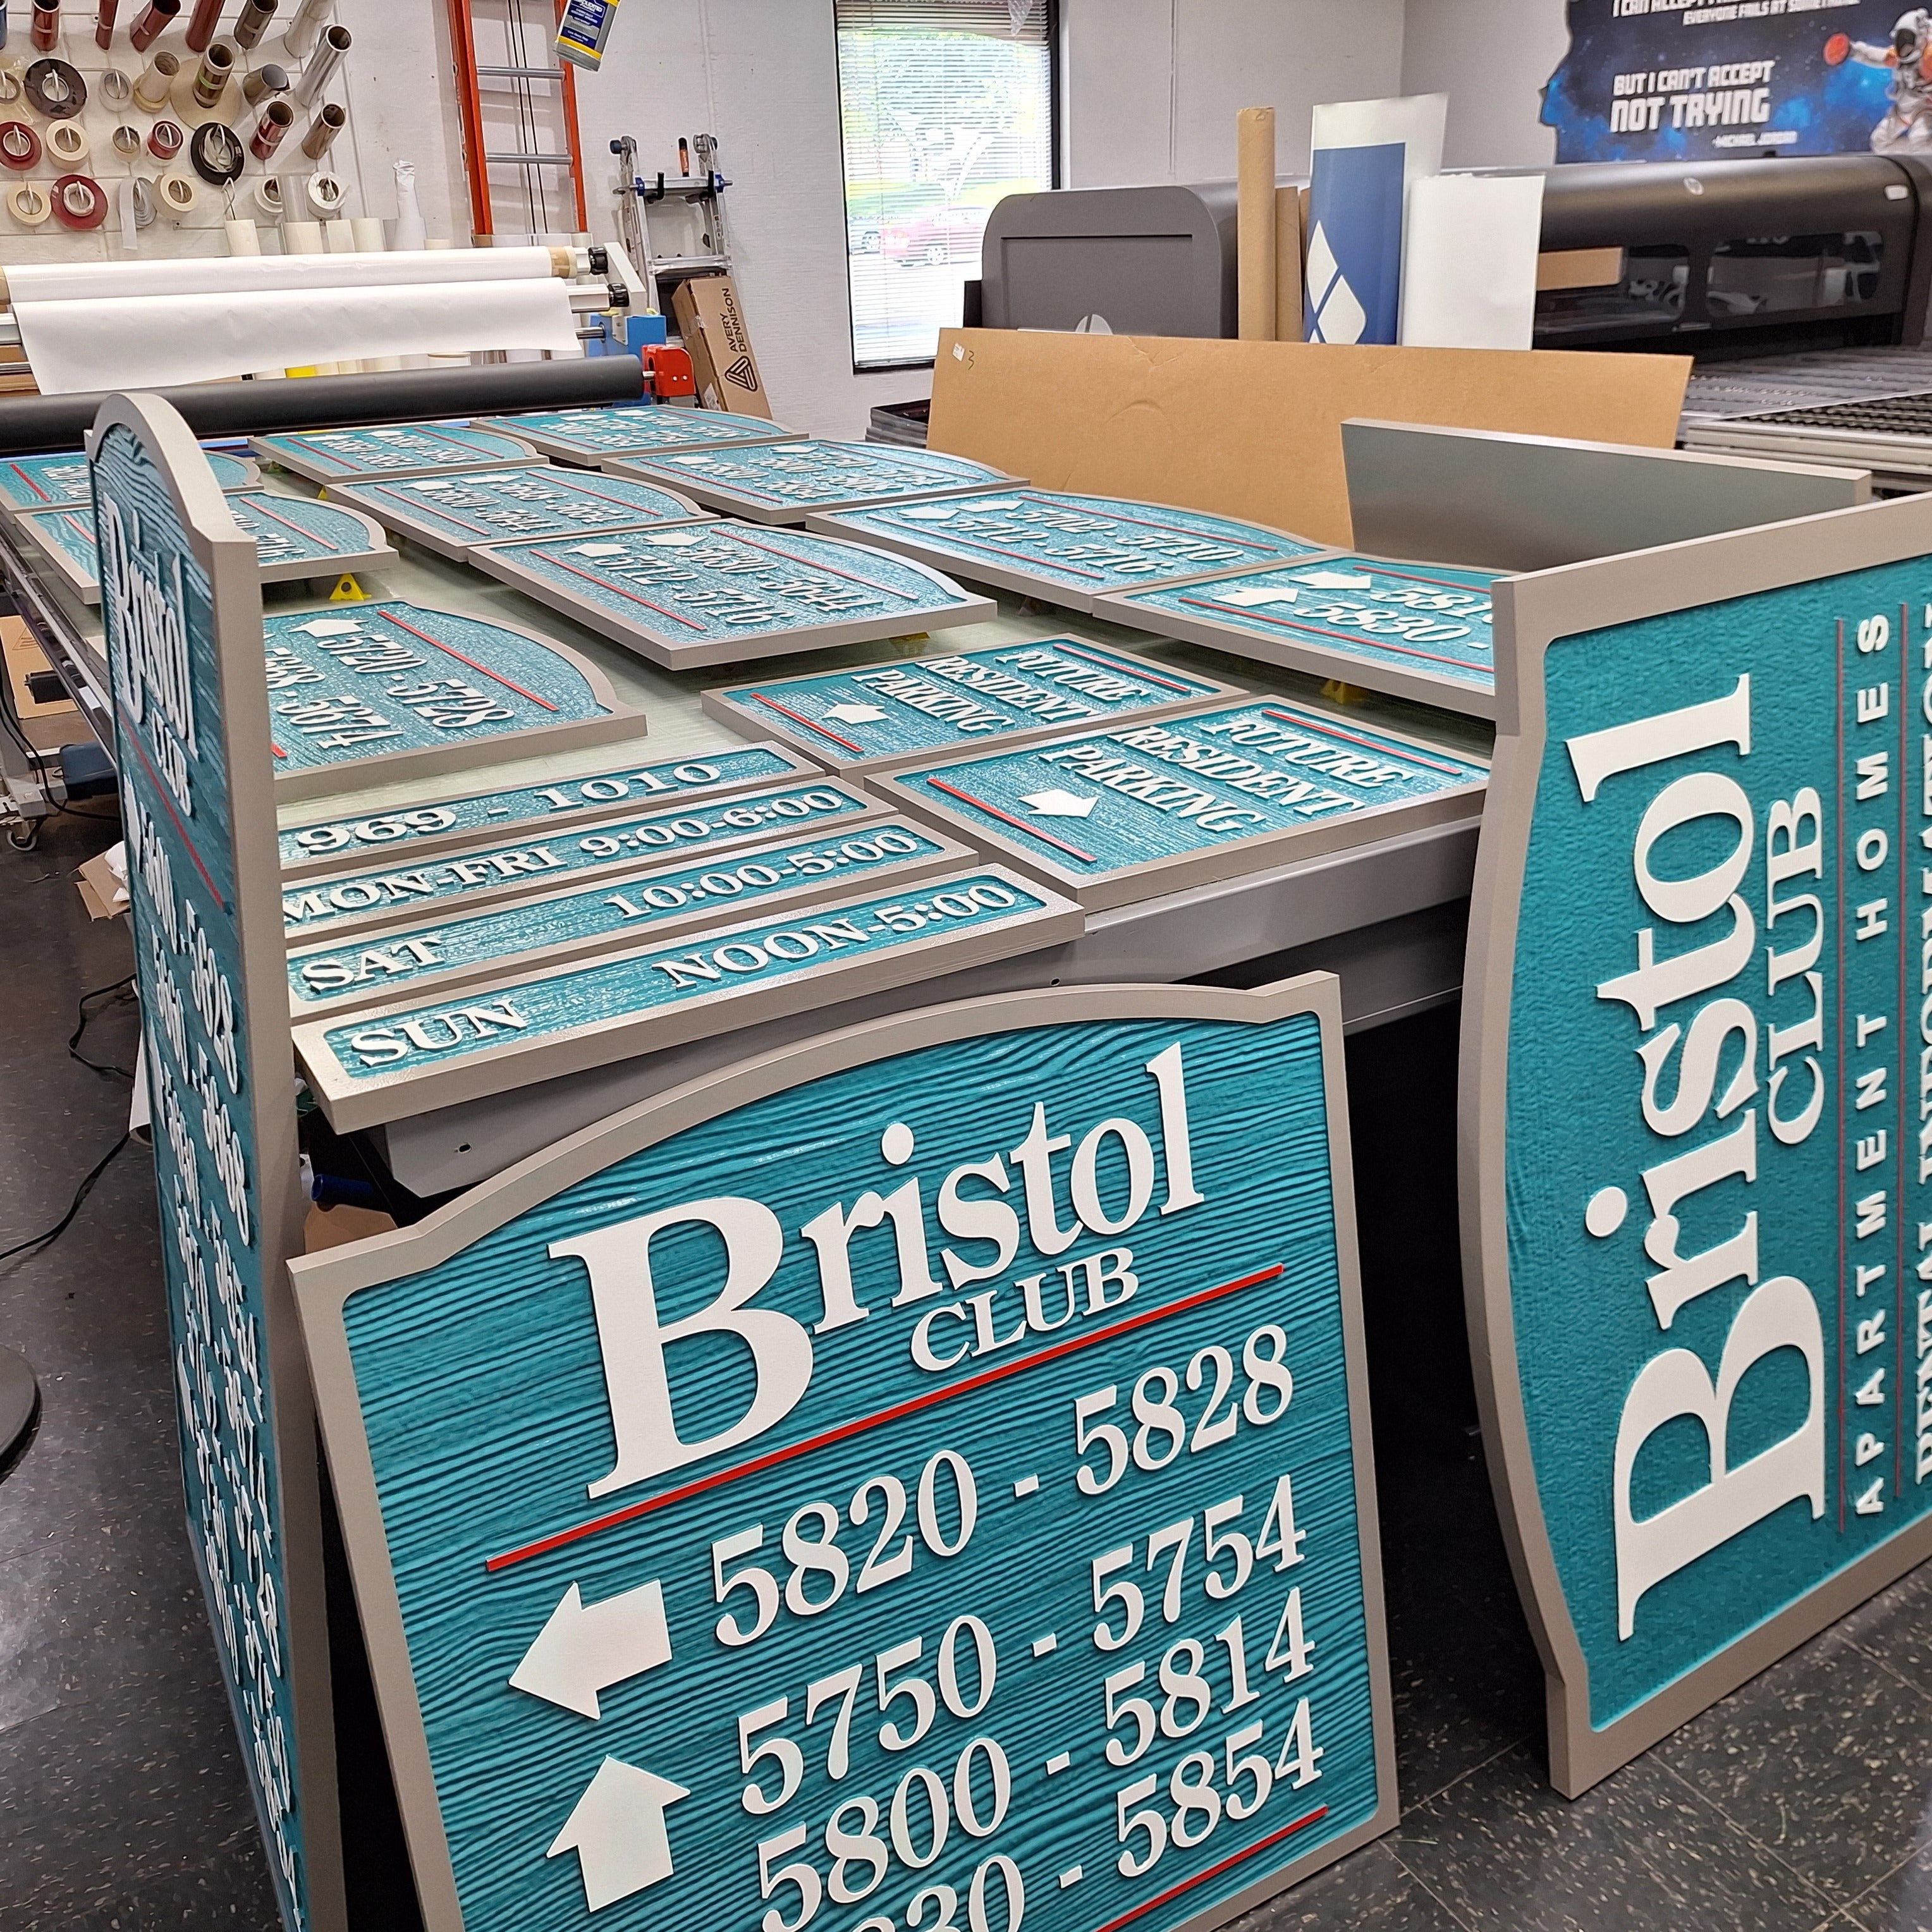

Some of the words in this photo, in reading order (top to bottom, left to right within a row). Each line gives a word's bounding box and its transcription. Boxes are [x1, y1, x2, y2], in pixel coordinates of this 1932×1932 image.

[1611, 99, 1665, 133] NOT
[1669, 88, 1770, 129] TRYING
[1613, 73, 1646, 96] BUT
[1648, 71, 1656, 92] I
[1656, 67, 1706, 92] CAN'T
[1707, 60, 1775, 87] ACCEPT
[719, 313, 739, 353] AVERY
[721, 288, 748, 352] DENNISON
[673, 544, 780, 573] 5630
[759, 576, 884, 611] 5644
[938, 518, 1051, 543] 5712
[1043, 543, 1175, 572] 5716
[1005, 508, 1118, 533] 5702
[1115, 533, 1244, 560] 5710
[594, 554, 699, 584] 5712
[673, 587, 795, 623] 5716
[1293, 602, 1471, 642] 5830
[1369, 587, 1493, 625] 581
[317, 634, 427, 673] 5720
[387, 678, 515, 728] 5728
[851, 669, 1015, 733] PARKING
[915, 656, 1093, 721] RESIDENT
[995, 649, 1151, 702] FUTURE
[276, 695, 405, 749] 5674
[1199, 717, 1414, 791] FUTURE
[297, 808, 457, 856] 969
[533, 763, 721, 812] 1010
[1038, 744, 1268, 833] PARKING
[1106, 725, 1364, 817] RESIDENT
[1856, 614, 1890, 941] HOMES
[284, 845, 568, 926] MON-FRI
[578, 789, 845, 858] 9:00-6:00
[301, 937, 446, 993] SAT
[602, 831, 921, 920] 10:00-5:00
[350, 996, 529, 1069] SUN
[651, 882, 1017, 991] NOON-5:00
[1767, 786, 1825, 1144] CLUB
[1565, 673, 1825, 1641] Bristol
[548, 1041, 1205, 1499] Bristol
[1856, 1014, 1888, 1515] APARTMENT
[909, 1247, 1142, 1373] CLUB
[712, 1449, 981, 1649] 5820
[1075, 1324, 1293, 1501] 5828
[737, 1614, 997, 1814] 5750
[1091, 1474, 1308, 1652] 5754
[758, 1737, 1012, 1932] 5800
[1104, 1587, 1317, 1766] 5814
[1115, 1697, 1325, 1878] 5854
